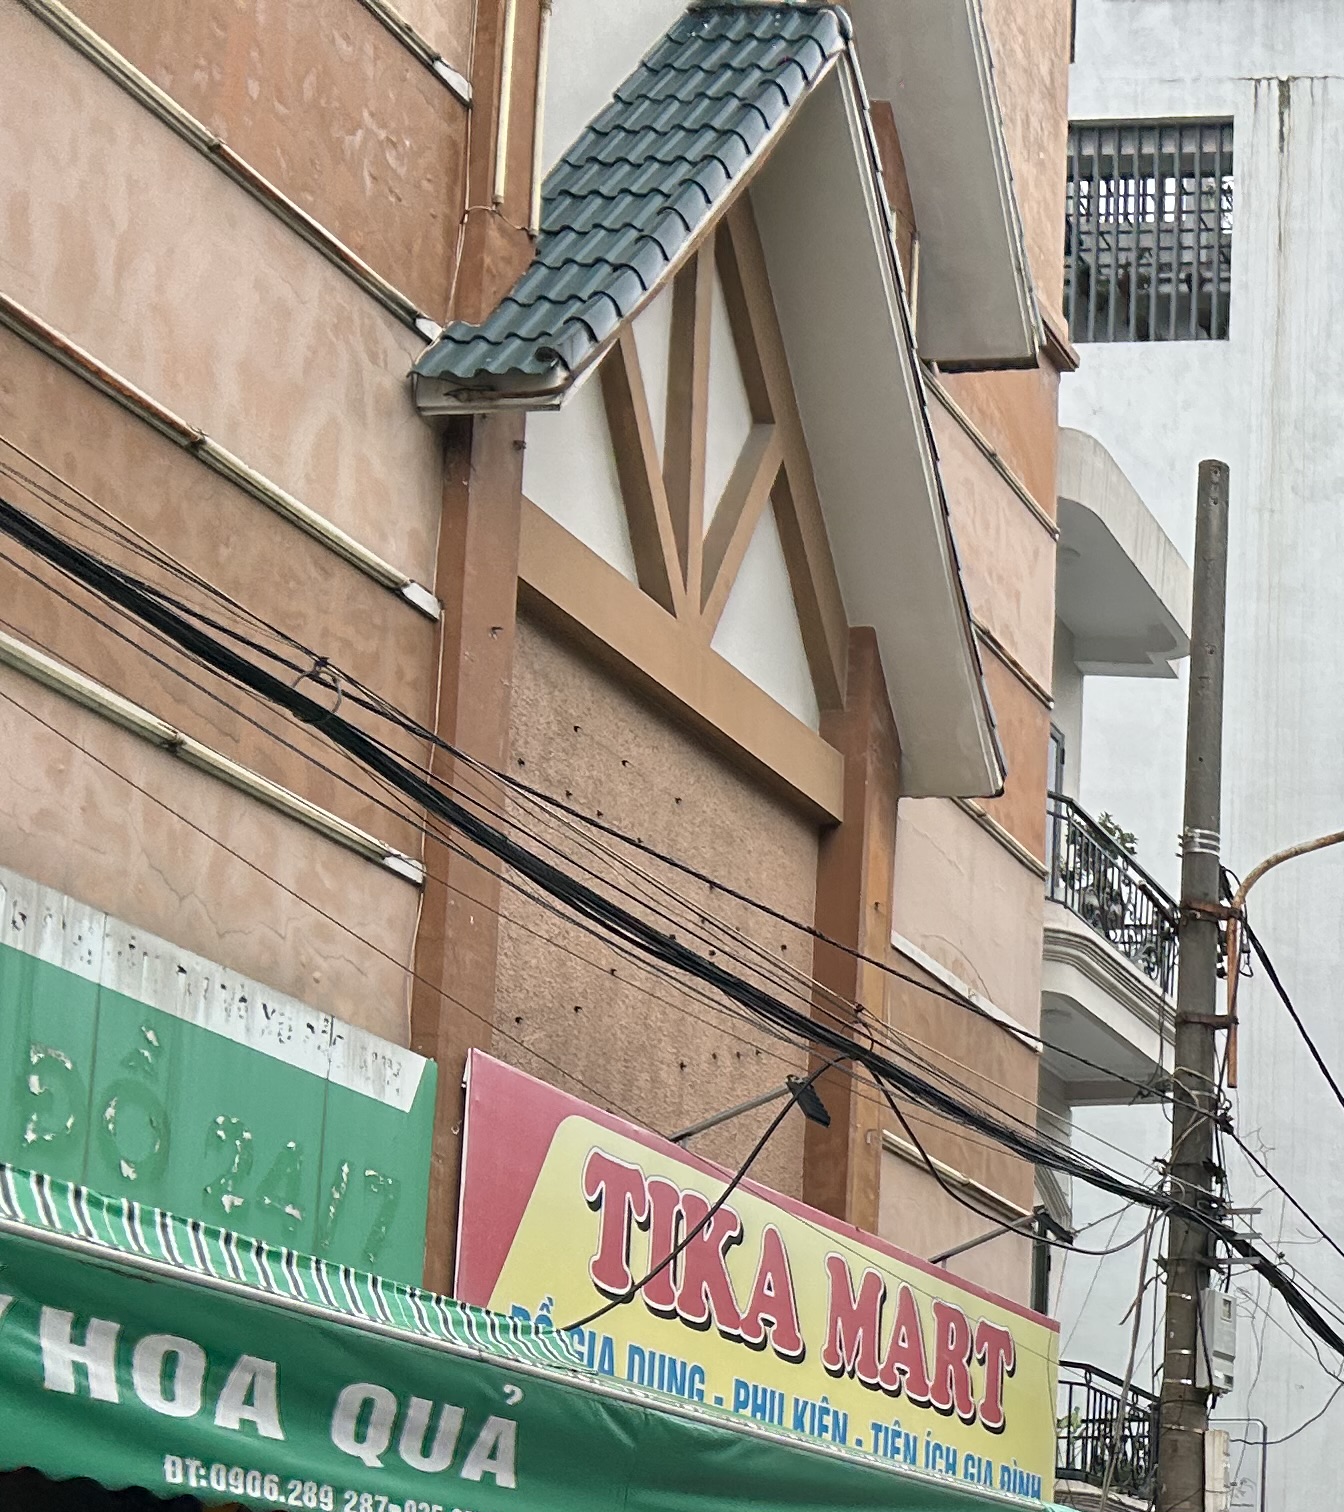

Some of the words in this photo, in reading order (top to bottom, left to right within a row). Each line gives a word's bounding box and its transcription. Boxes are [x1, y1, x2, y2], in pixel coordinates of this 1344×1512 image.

[582, 1146, 803, 1363] TIKA
[822, 1253, 1016, 1432] MART
[39, 1304, 286, 1441] HOA
[330, 1384, 525, 1490] QUẢ
[163, 1453, 334, 1512] ĐT:0906.289
